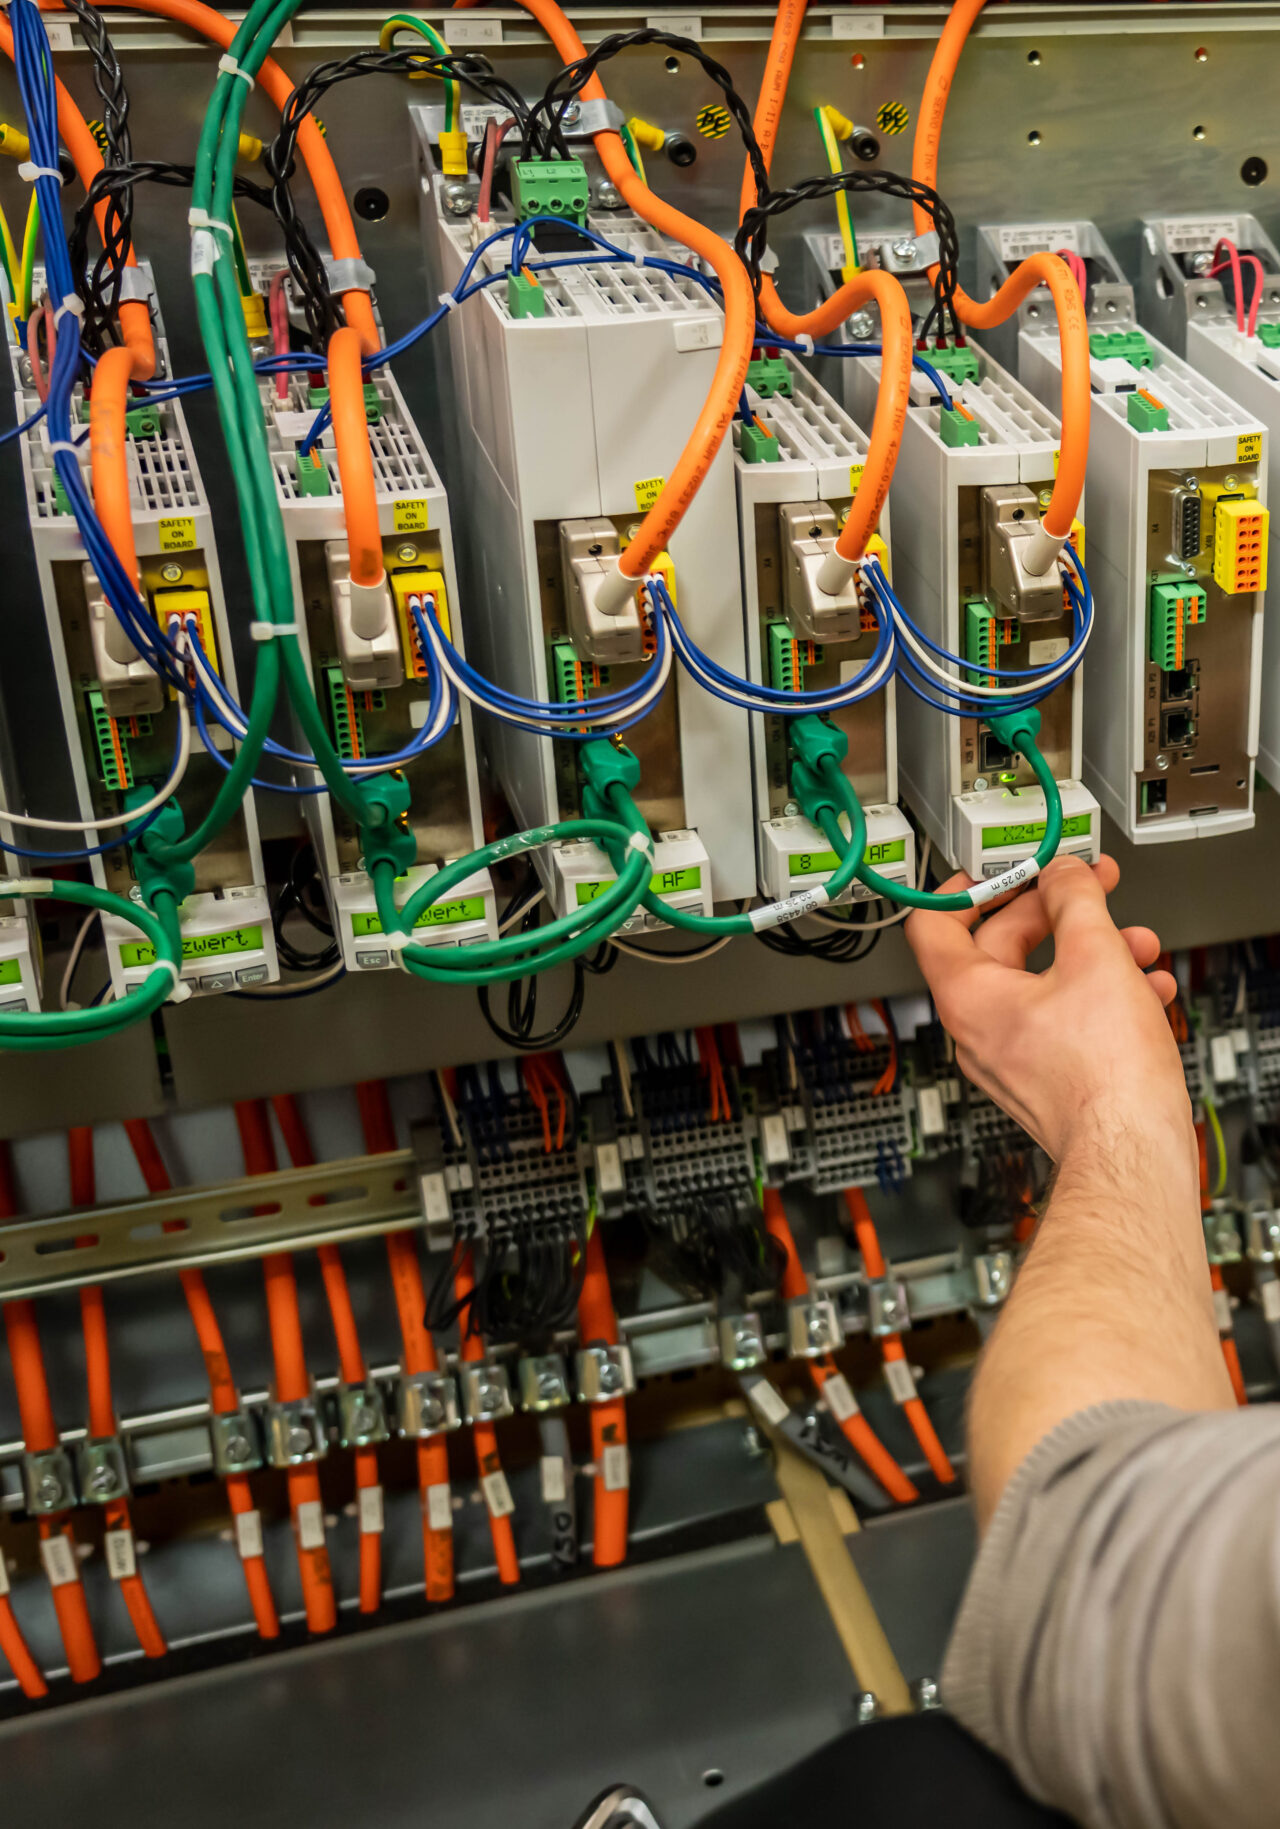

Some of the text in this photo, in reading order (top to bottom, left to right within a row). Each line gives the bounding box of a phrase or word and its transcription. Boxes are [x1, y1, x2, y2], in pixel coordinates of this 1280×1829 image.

[882, 111, 903, 127] PE
[1238, 434, 1260, 444] SAFETY
[1238, 453, 1260, 462] BOARD
[636, 478, 664, 491] SAFETY
[646, 491, 657, 499] ON
[395, 501, 425, 510] SAFETY
[640, 502, 655, 510] BOA
[405, 512, 417, 520] ON
[160, 518, 192, 528] SAFETY
[397, 522, 426, 531] BOARD
[1152, 523, 1160, 533] X4
[171, 530, 184, 538] ON
[163, 540, 194, 549] BOARD
[1151, 569, 1159, 582] X31
[1148, 673, 1156, 682] P2
[965, 738, 973, 764] X25 P1
[962, 781, 970, 790] H1
[1003, 817, 1079, 840] X24-25
[800, 843, 891, 870] 8 AF
[588, 870, 687, 899] 7 AF
[990, 883, 1001, 891] m
[363, 957, 381, 965] Esc
[241, 973, 264, 983] Enter
